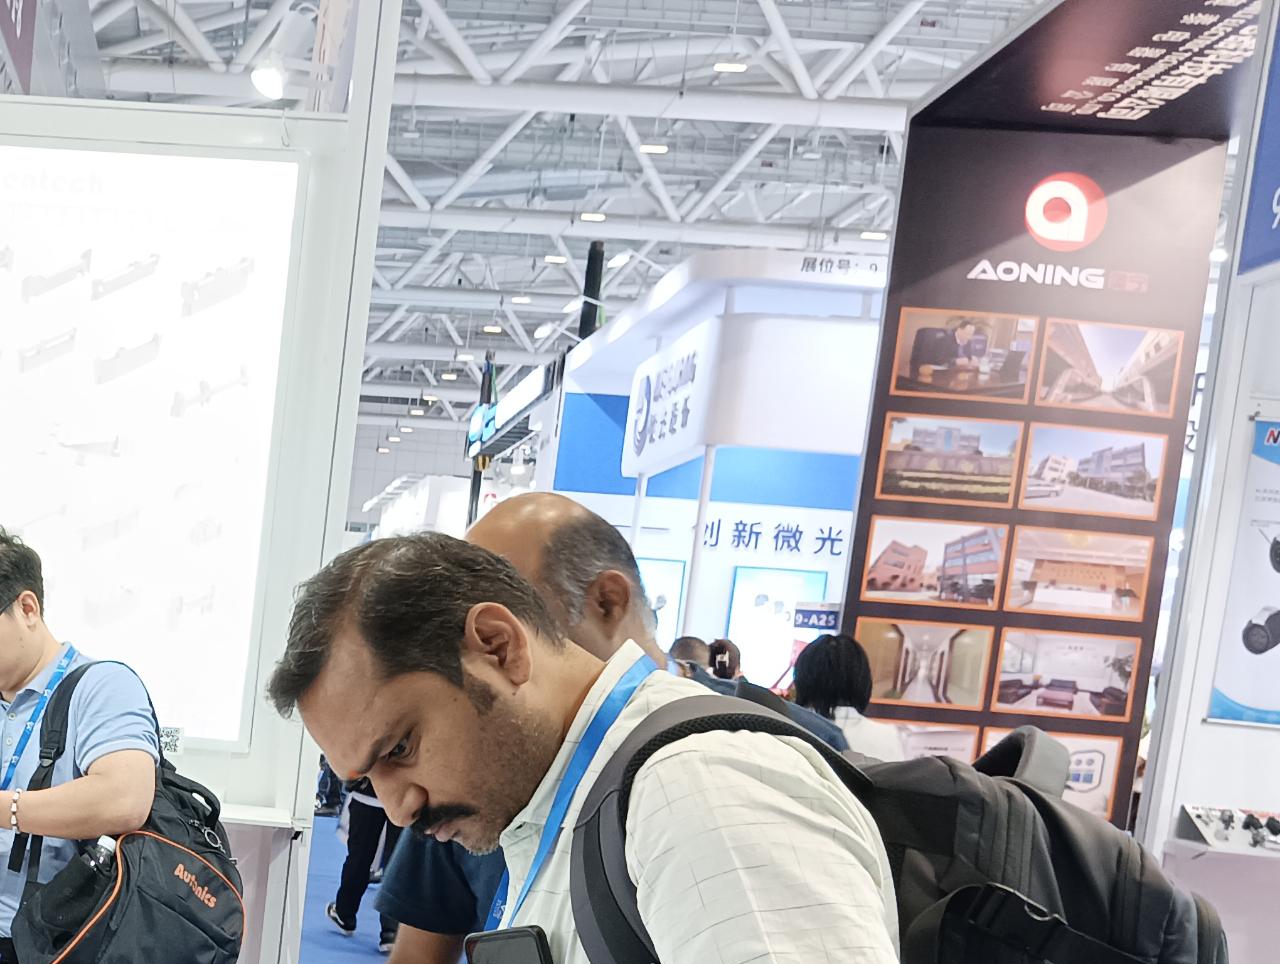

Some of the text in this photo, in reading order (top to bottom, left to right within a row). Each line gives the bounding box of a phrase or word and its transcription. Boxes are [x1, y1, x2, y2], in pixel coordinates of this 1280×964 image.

[966, 259, 1105, 290] AONING
[703, 518, 844, 556] 创新微光
[794, 611, 837, 627] 9-A25
[173, 862, 217, 909] Autonics
